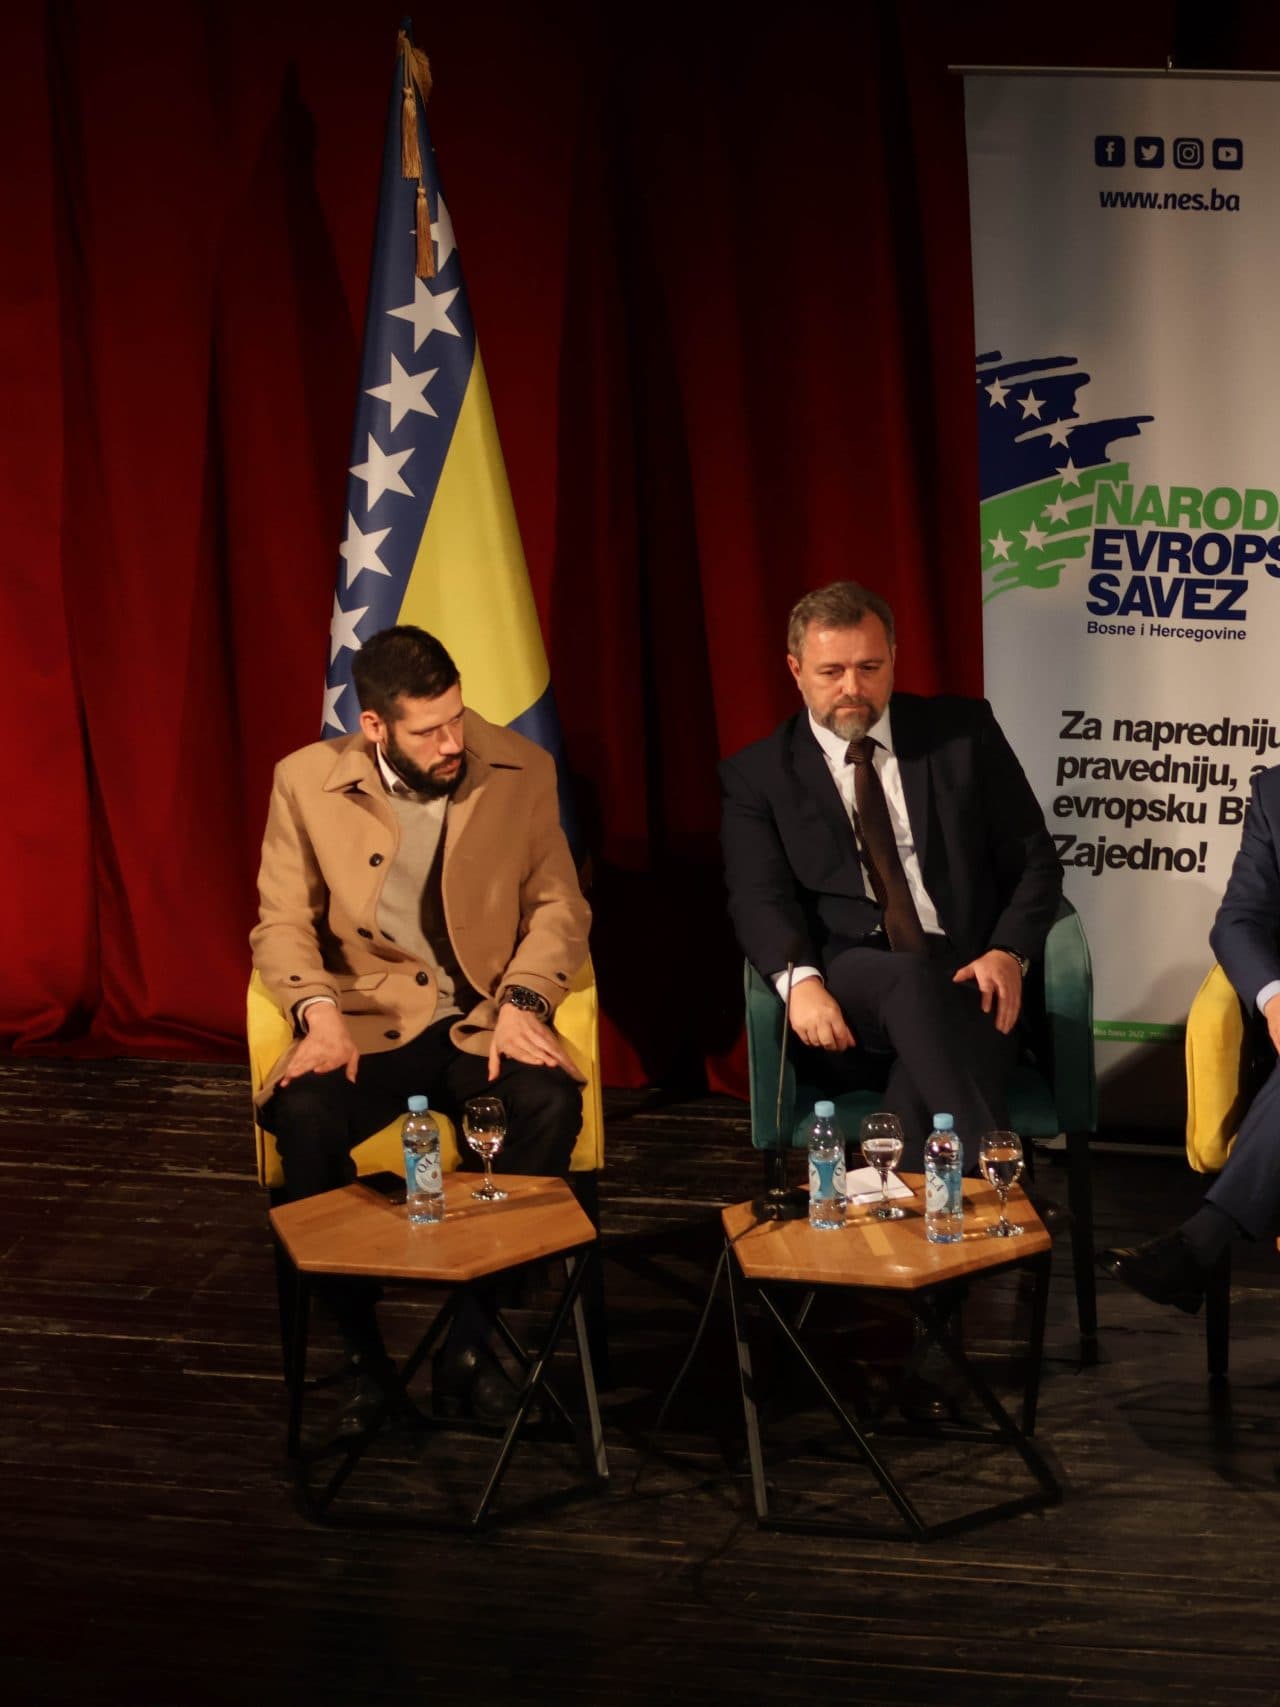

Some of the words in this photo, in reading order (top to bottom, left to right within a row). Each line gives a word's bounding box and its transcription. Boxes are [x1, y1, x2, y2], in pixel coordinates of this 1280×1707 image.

[1098, 187, 1241, 212] www.nes.ba
[1085, 573, 1249, 621] SAVEZ
[1086, 621, 1136, 637] Bosne
[1140, 623, 1146, 637] i
[1149, 624, 1247, 642] Hercegovine
[1059, 710, 1102, 741] Za
[1055, 754, 1238, 793] pravedniju,
[1052, 794, 1207, 828] evropsku
[1052, 834, 1208, 876] Zajedno!
